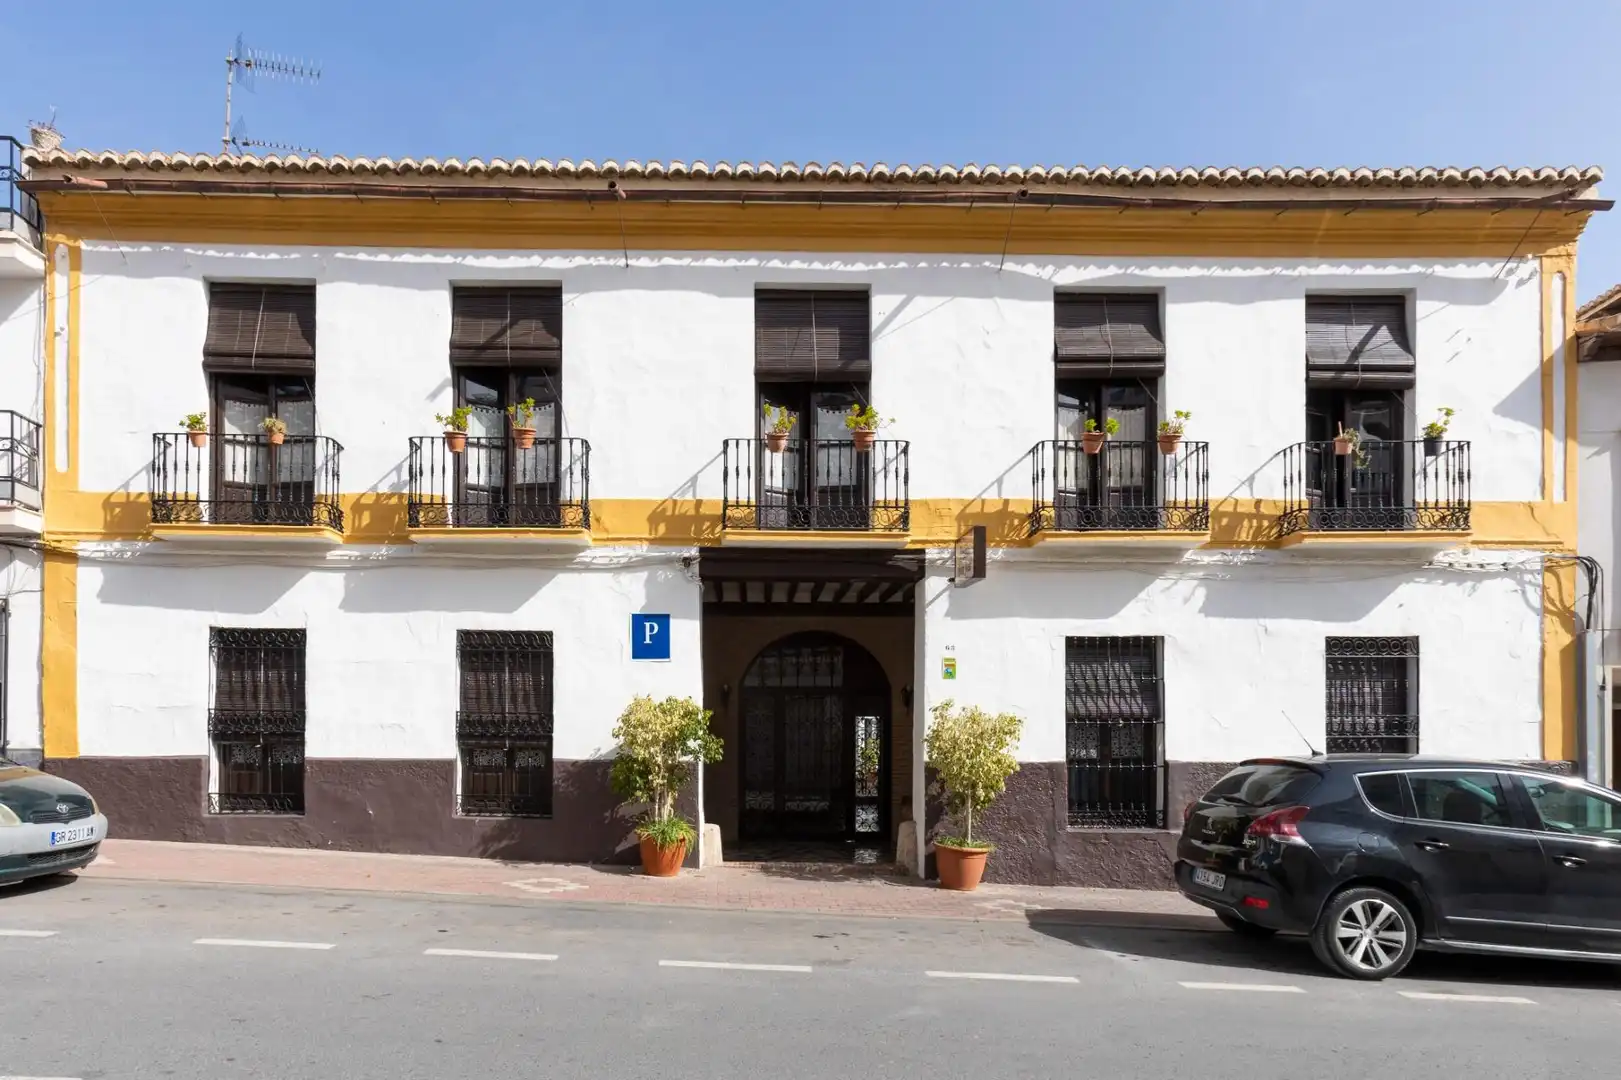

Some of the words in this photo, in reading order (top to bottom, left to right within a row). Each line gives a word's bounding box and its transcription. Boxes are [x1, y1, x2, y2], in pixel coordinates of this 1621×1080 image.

[643, 621, 659, 644] P
[56, 831, 66, 843] GR
[67, 828, 85, 841] 2311
